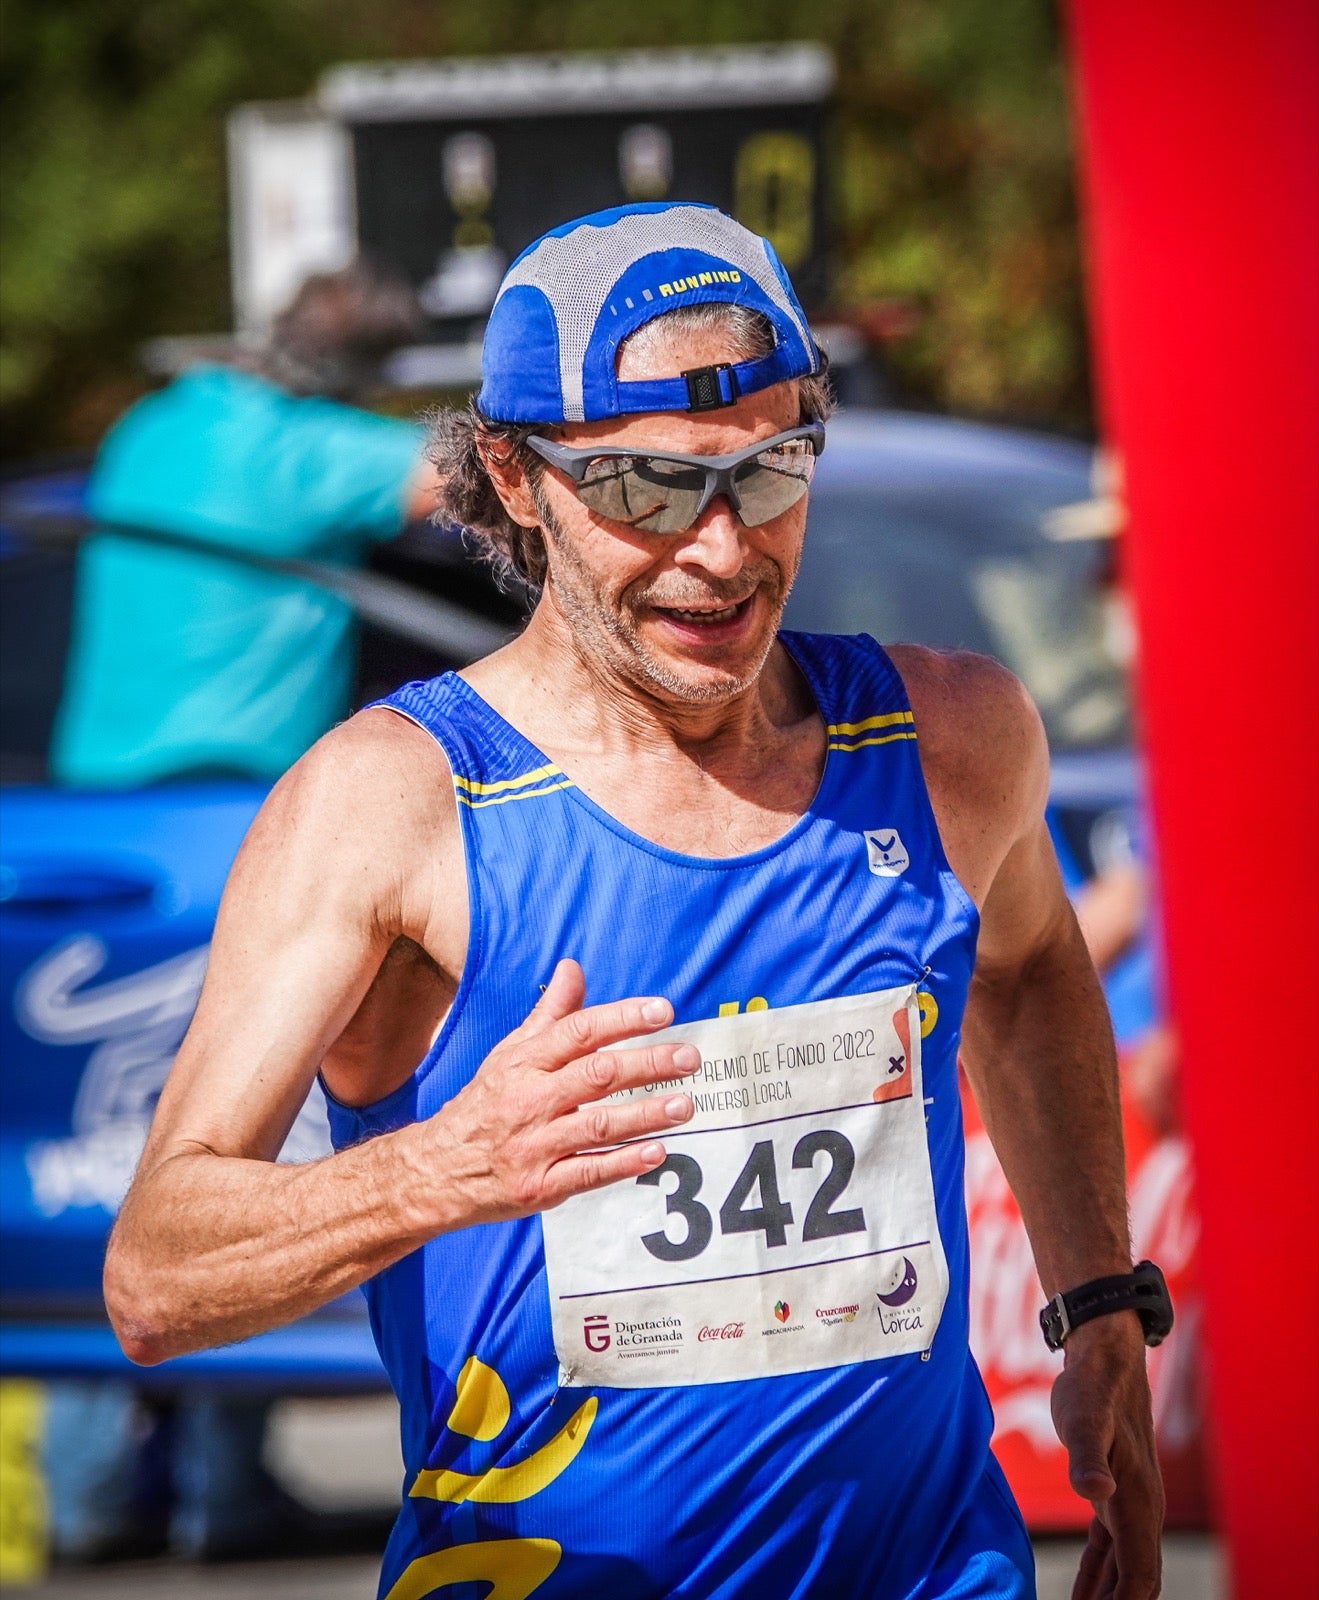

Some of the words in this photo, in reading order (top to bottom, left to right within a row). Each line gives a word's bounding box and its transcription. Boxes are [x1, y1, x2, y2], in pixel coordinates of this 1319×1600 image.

[659, 270, 741, 298] RUNNING
[754, 1051, 771, 1075] DE
[776, 1043, 826, 1070] FONDO
[832, 1029, 876, 1062] 2022
[690, 1088, 750, 1113] NIVERSO
[753, 1080, 792, 1105] LORCA
[635, 1129, 867, 1264] 342
[815, 1304, 860, 1318] Cruzcampo
[615, 1317, 682, 1334] Diputación
[697, 1322, 746, 1342] Coca-Cola
[616, 1335, 630, 1346] de
[632, 1330, 683, 1345] Granada
